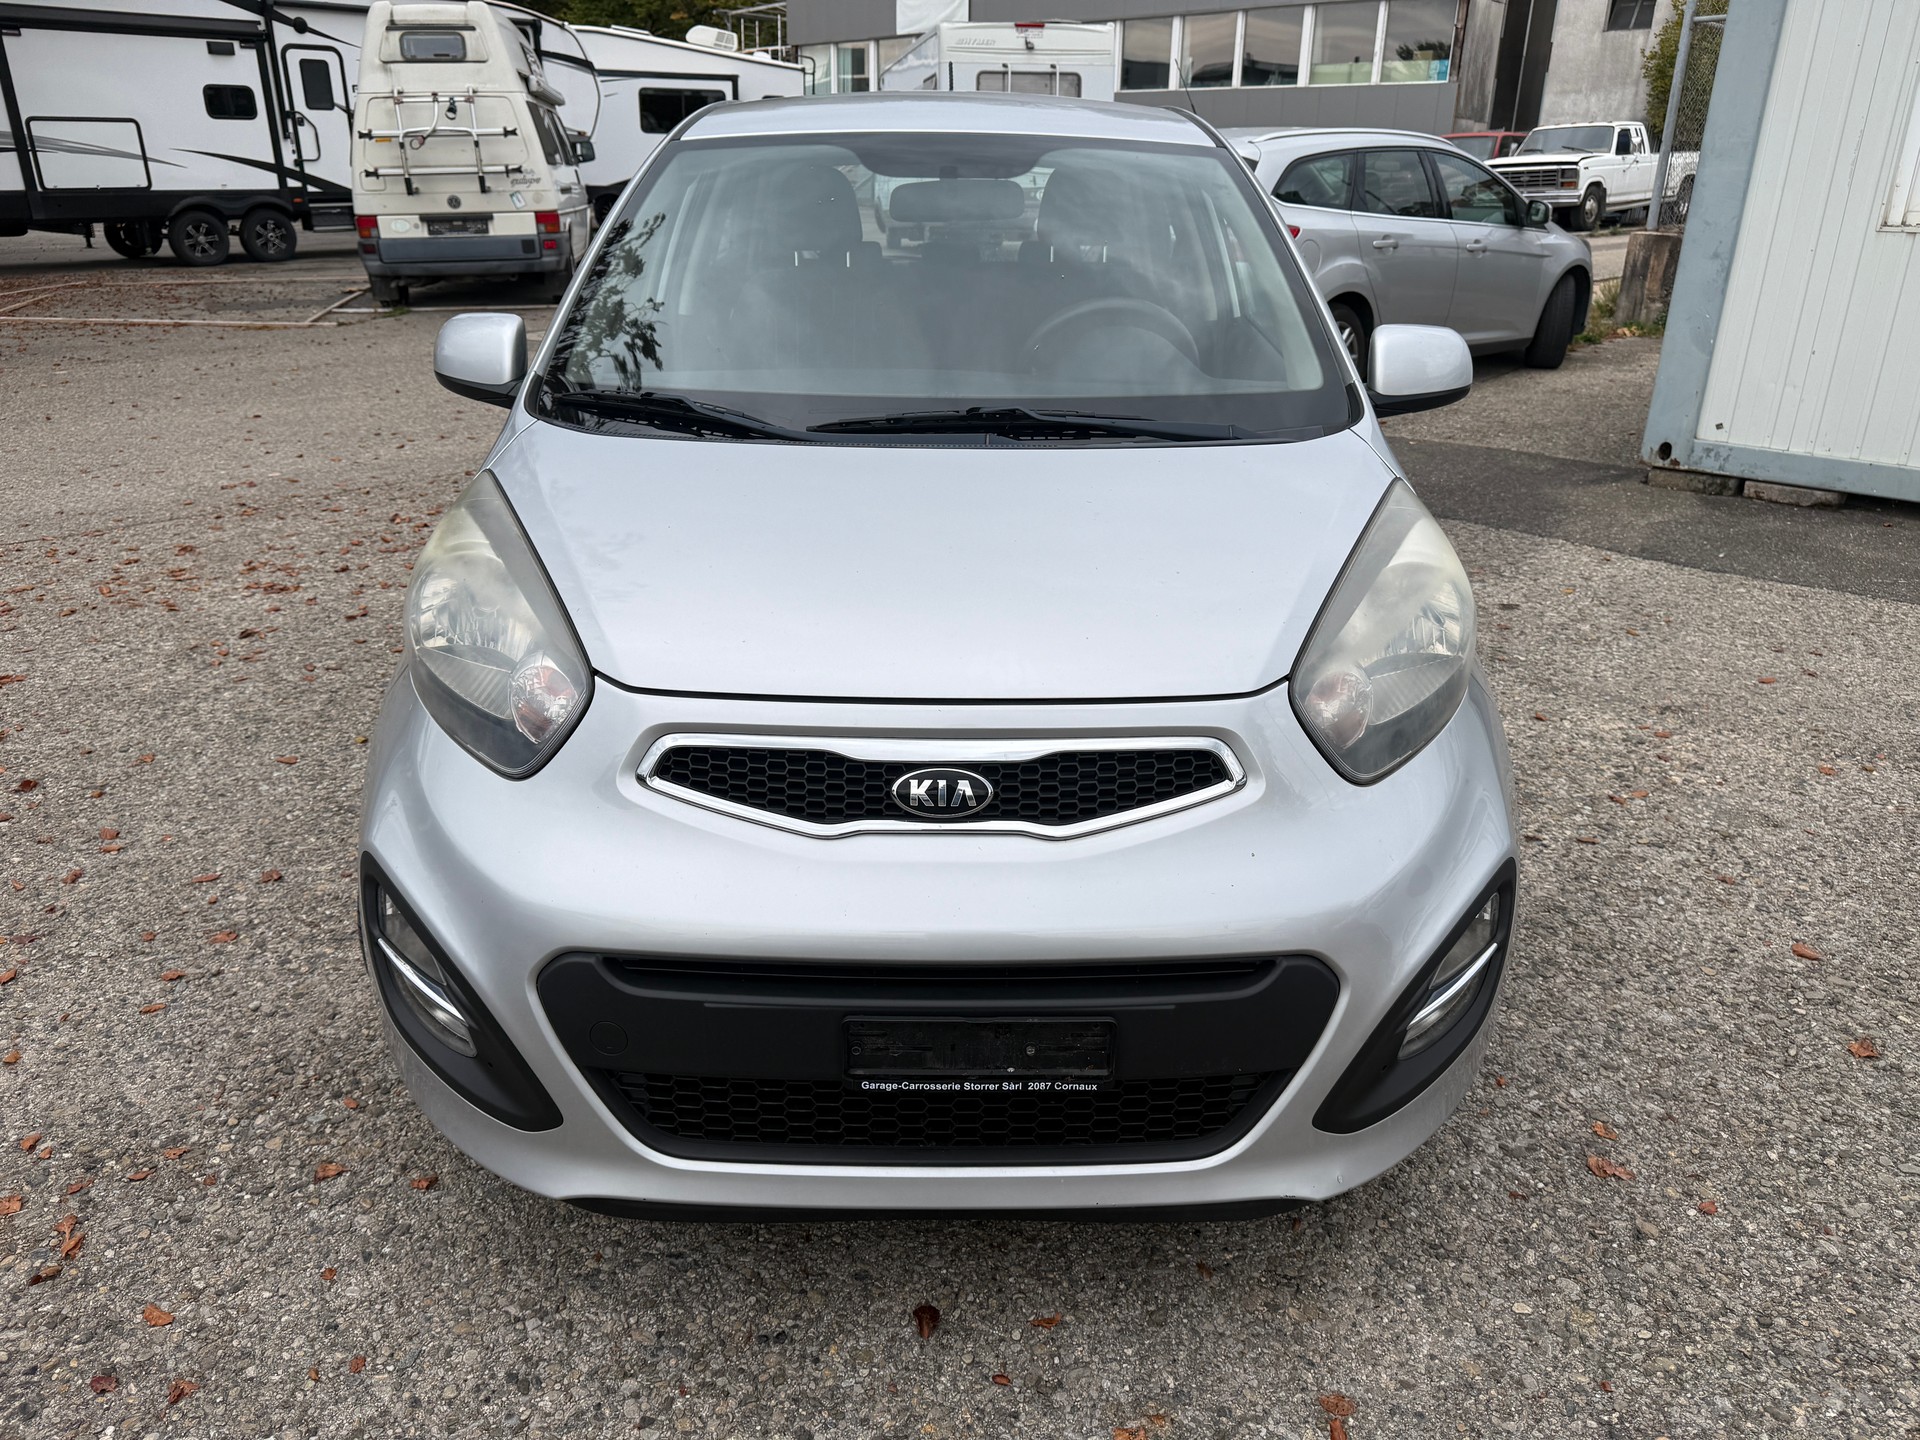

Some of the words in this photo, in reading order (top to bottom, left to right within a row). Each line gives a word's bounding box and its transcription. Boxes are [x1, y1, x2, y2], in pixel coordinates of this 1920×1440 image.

[908, 779, 977, 807] KIA
[861, 1081, 961, 1092] Garage-Carrosserie
[963, 1081, 1000, 1091] Storrer
[1001, 1081, 1023, 1091] Sàrl
[1027, 1081, 1052, 1091] 2087
[1054, 1081, 1098, 1091] Cornaux
